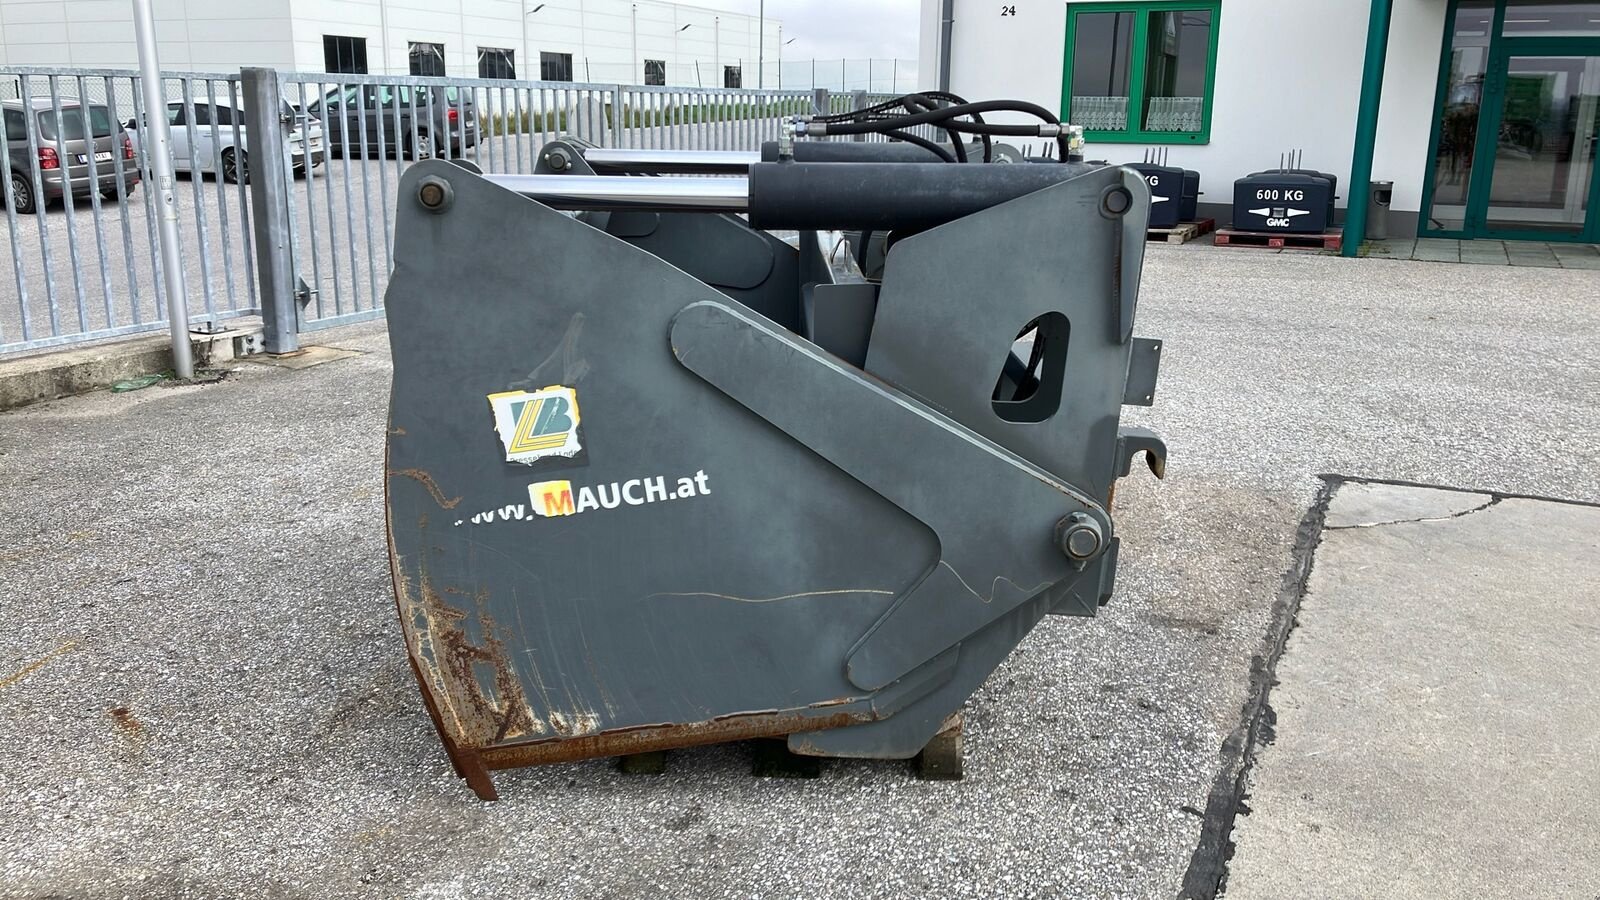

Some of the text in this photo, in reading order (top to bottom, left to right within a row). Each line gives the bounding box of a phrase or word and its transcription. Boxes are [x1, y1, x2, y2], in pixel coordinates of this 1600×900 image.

[1000, 5, 1016, 16] 24
[1256, 189, 1304, 201] 600 KG
[1266, 217, 1290, 227] GMC
[454, 469, 711, 526] ww.MAUCH.at
